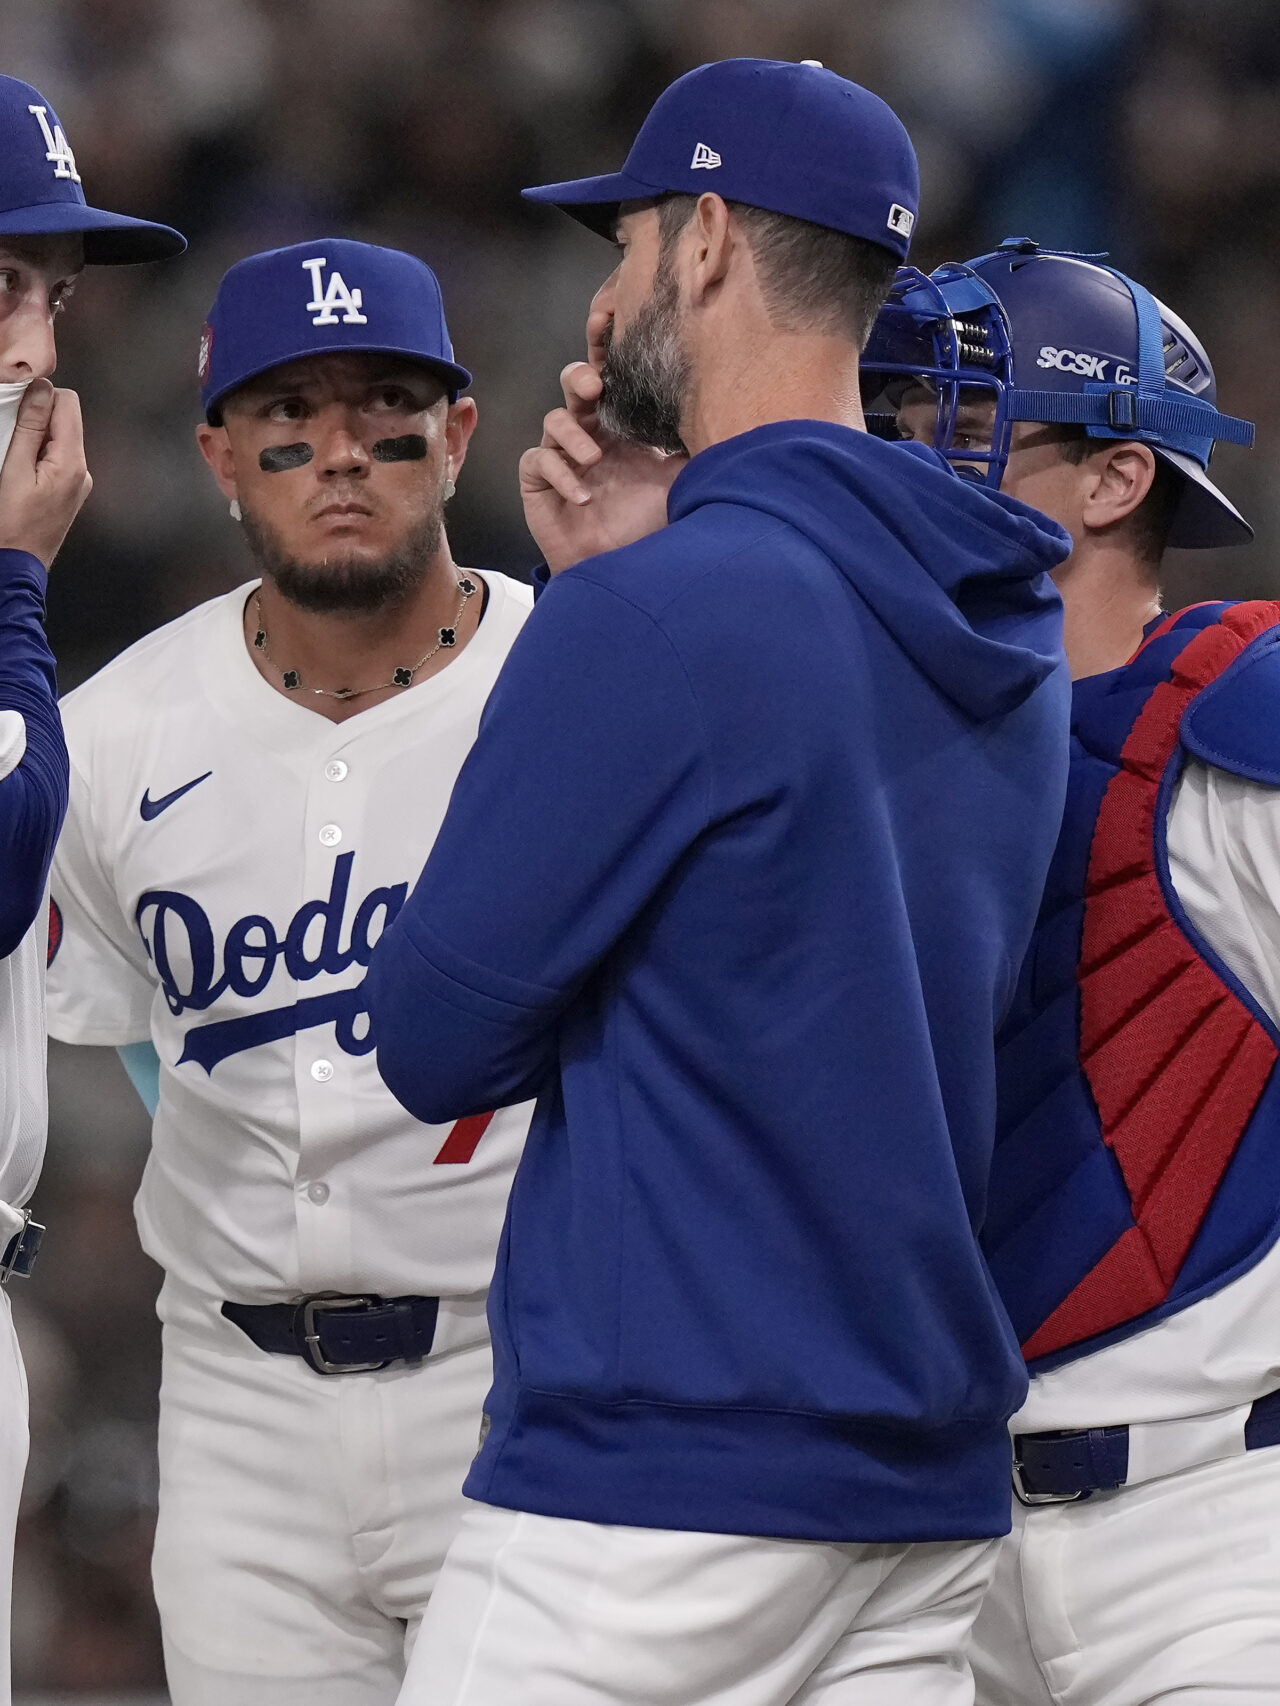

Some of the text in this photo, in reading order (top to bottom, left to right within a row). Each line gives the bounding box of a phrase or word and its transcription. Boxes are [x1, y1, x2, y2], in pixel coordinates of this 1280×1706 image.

[28, 105, 81, 183] LA
[302, 257, 368, 326] LA
[1036, 346, 1110, 381] SCSK
